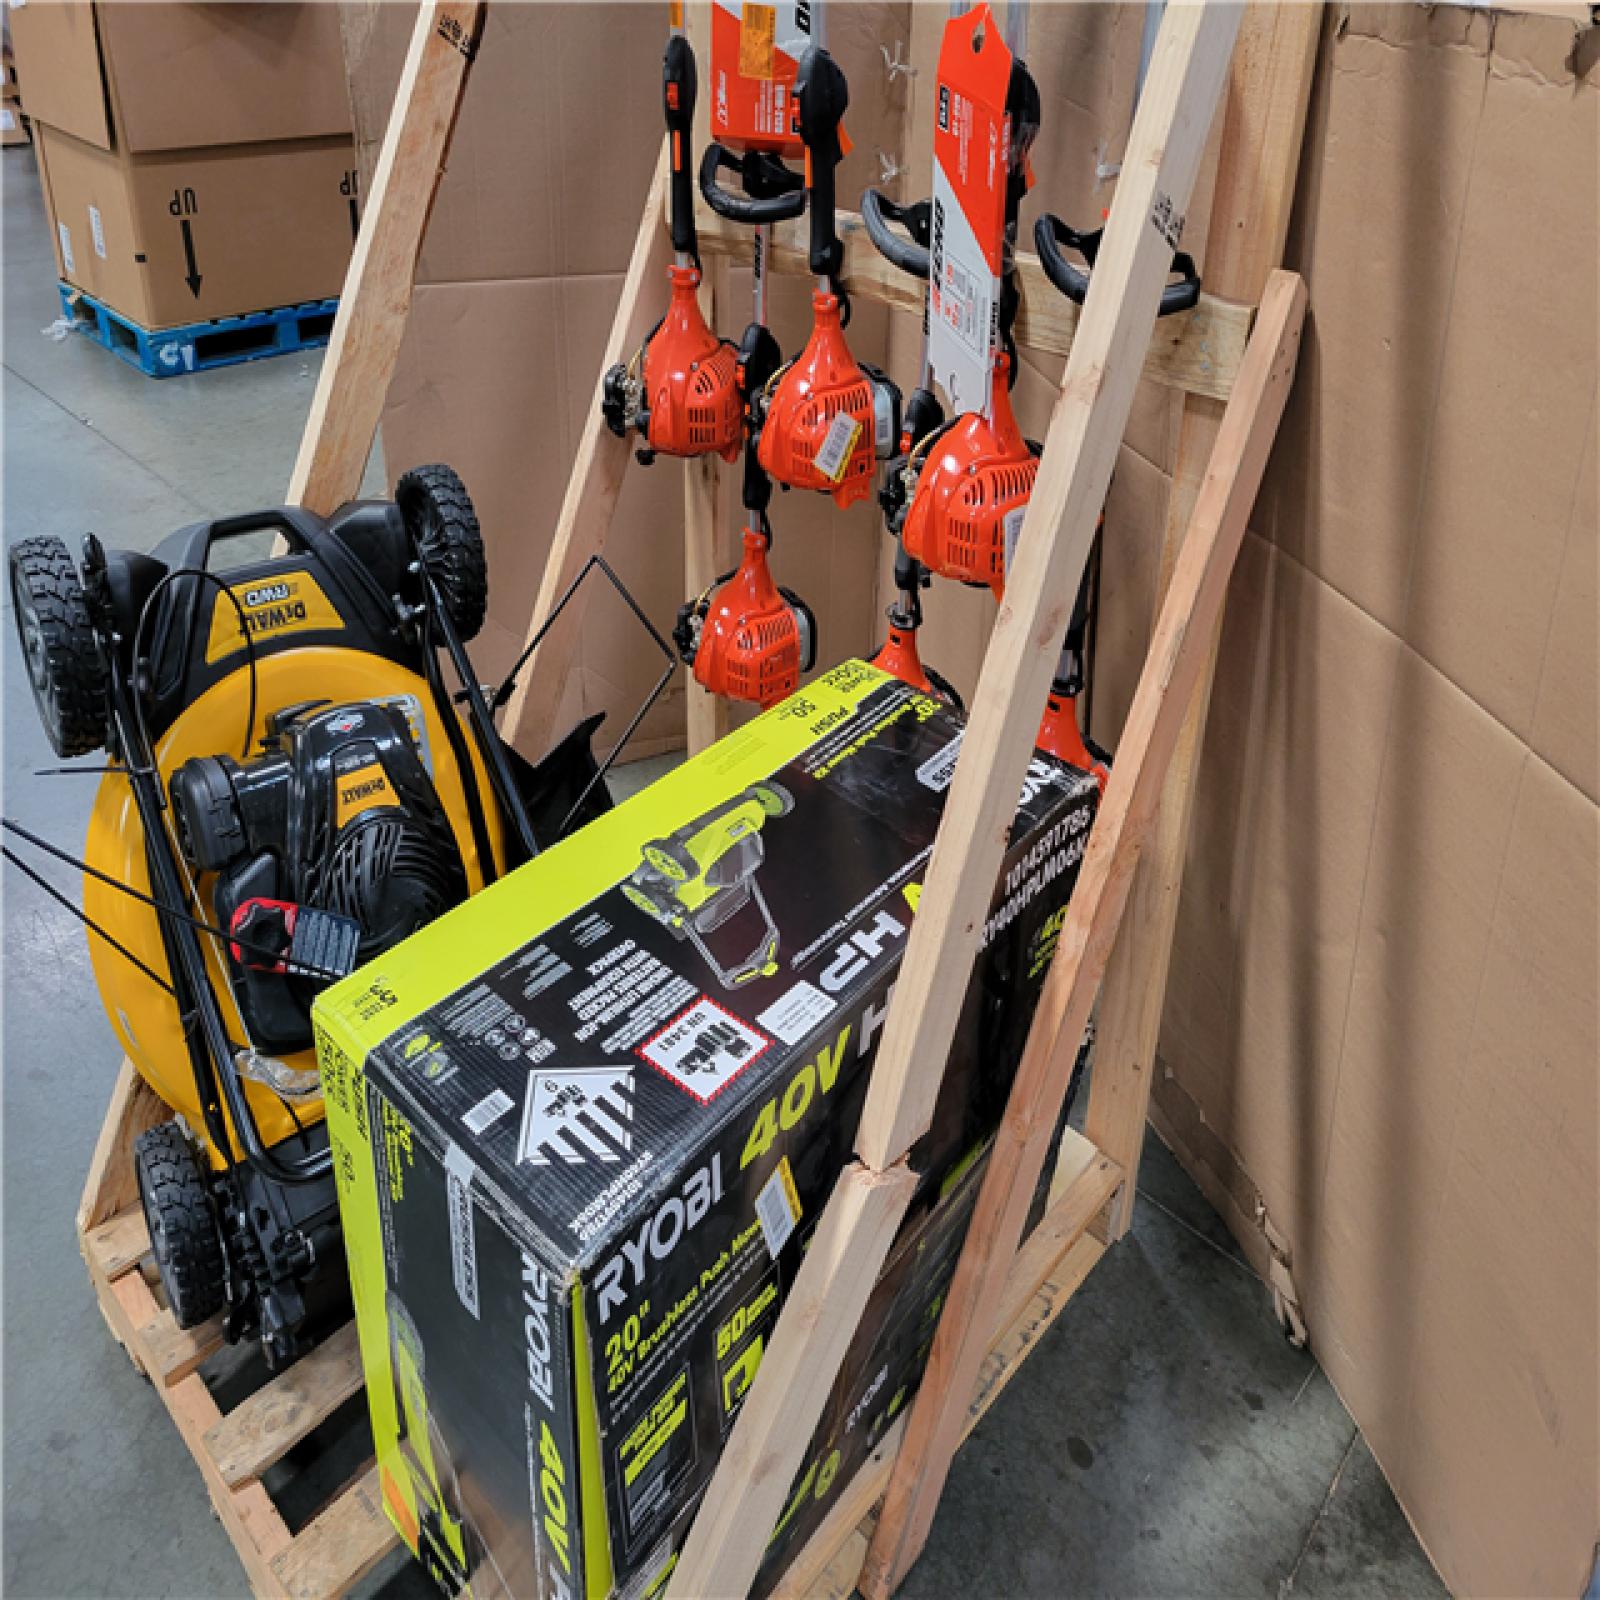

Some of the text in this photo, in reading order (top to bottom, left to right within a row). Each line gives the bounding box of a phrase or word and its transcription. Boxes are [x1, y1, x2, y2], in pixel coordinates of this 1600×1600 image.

[169, 188, 199, 217] UP
[932, 196, 944, 291] ECHO
[793, 700, 817, 718] 50
[809, 707, 850, 735] PUSH
[588, 940, 635, 973] OVERPACK
[820, 910, 905, 991] HP
[570, 970, 623, 1008] EQUIPMENT
[615, 960, 660, 991] BATTERIES
[577, 991, 615, 1021] PACKED
[658, 1012, 706, 1051] UN 3481
[591, 1153, 725, 1325] RYOBI
[740, 1024, 850, 1170] 40V
[605, 1299, 650, 1365] 20"
[607, 1357, 633, 1393] 40V
[637, 1288, 698, 1359] Brushless
[699, 1251, 729, 1289] Push
[717, 1307, 745, 1360] 50
[520, 1252, 556, 1412] RYOBI
[539, 1420, 571, 1577] 40V
